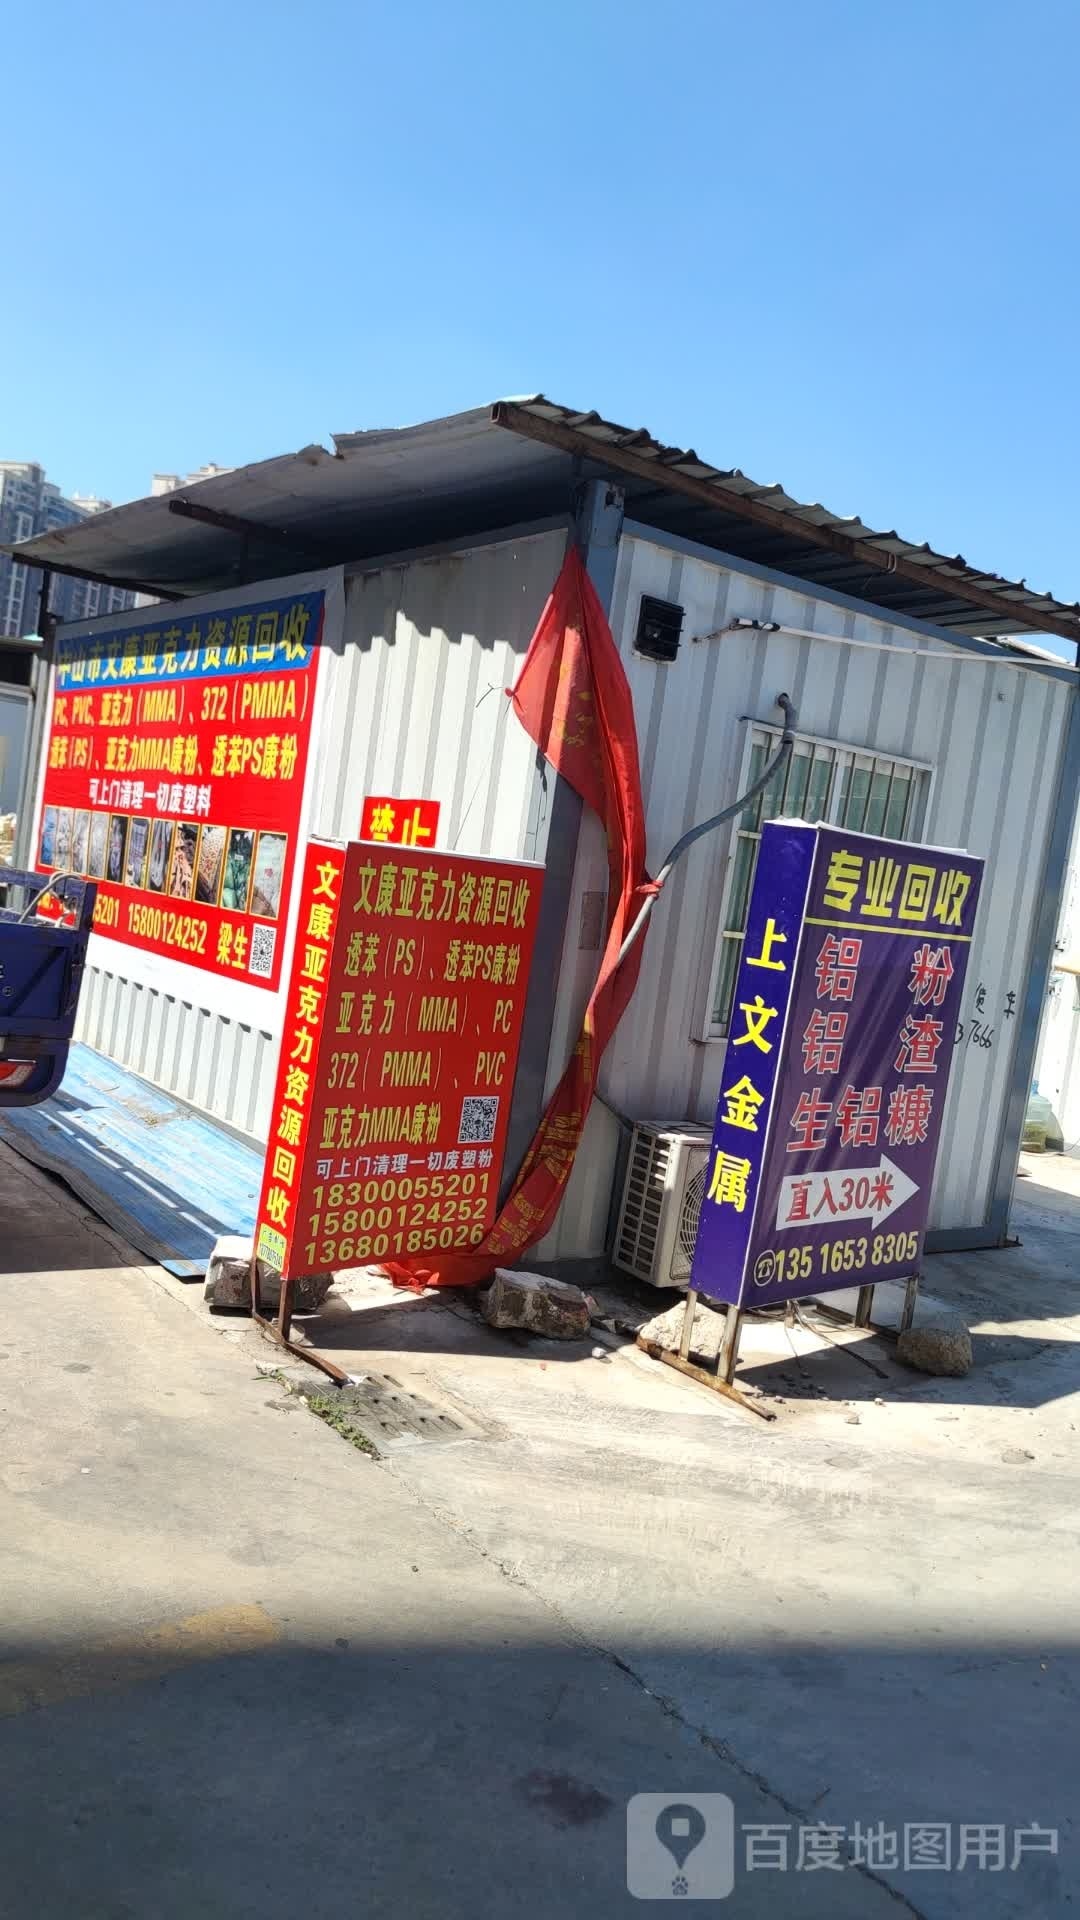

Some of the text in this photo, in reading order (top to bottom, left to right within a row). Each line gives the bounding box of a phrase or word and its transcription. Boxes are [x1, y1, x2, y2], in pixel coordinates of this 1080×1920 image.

[56, 604, 310, 686] 中山市文康亚克力资源回收
[89, 778, 212, 817] 可上门清理一切废塑料
[369, 803, 431, 847] 禁止
[353, 857, 531, 929] 文康亚克力资源回收
[823, 849, 972, 927] 专业回收
[128, 902, 208, 955] 15800124252
[216, 921, 248, 970] 梁生
[263, 860, 341, 1229] 文康亚克力资源回收
[706, 918, 787, 1213] 上文金属
[319, 1101, 441, 1149] 亚克力MMA康粉
[785, 1083, 933, 1153] 生铝糠
[316, 1148, 494, 1180] 可上门清理一切废塑粉
[312, 1172, 489, 1209] 18300055201
[785, 1171, 894, 1223] 直入30米
[308, 1197, 488, 1237] 15800124252
[304, 1223, 485, 1266] 13680185026
[775, 1231, 919, 1283] 135 1653 8305
